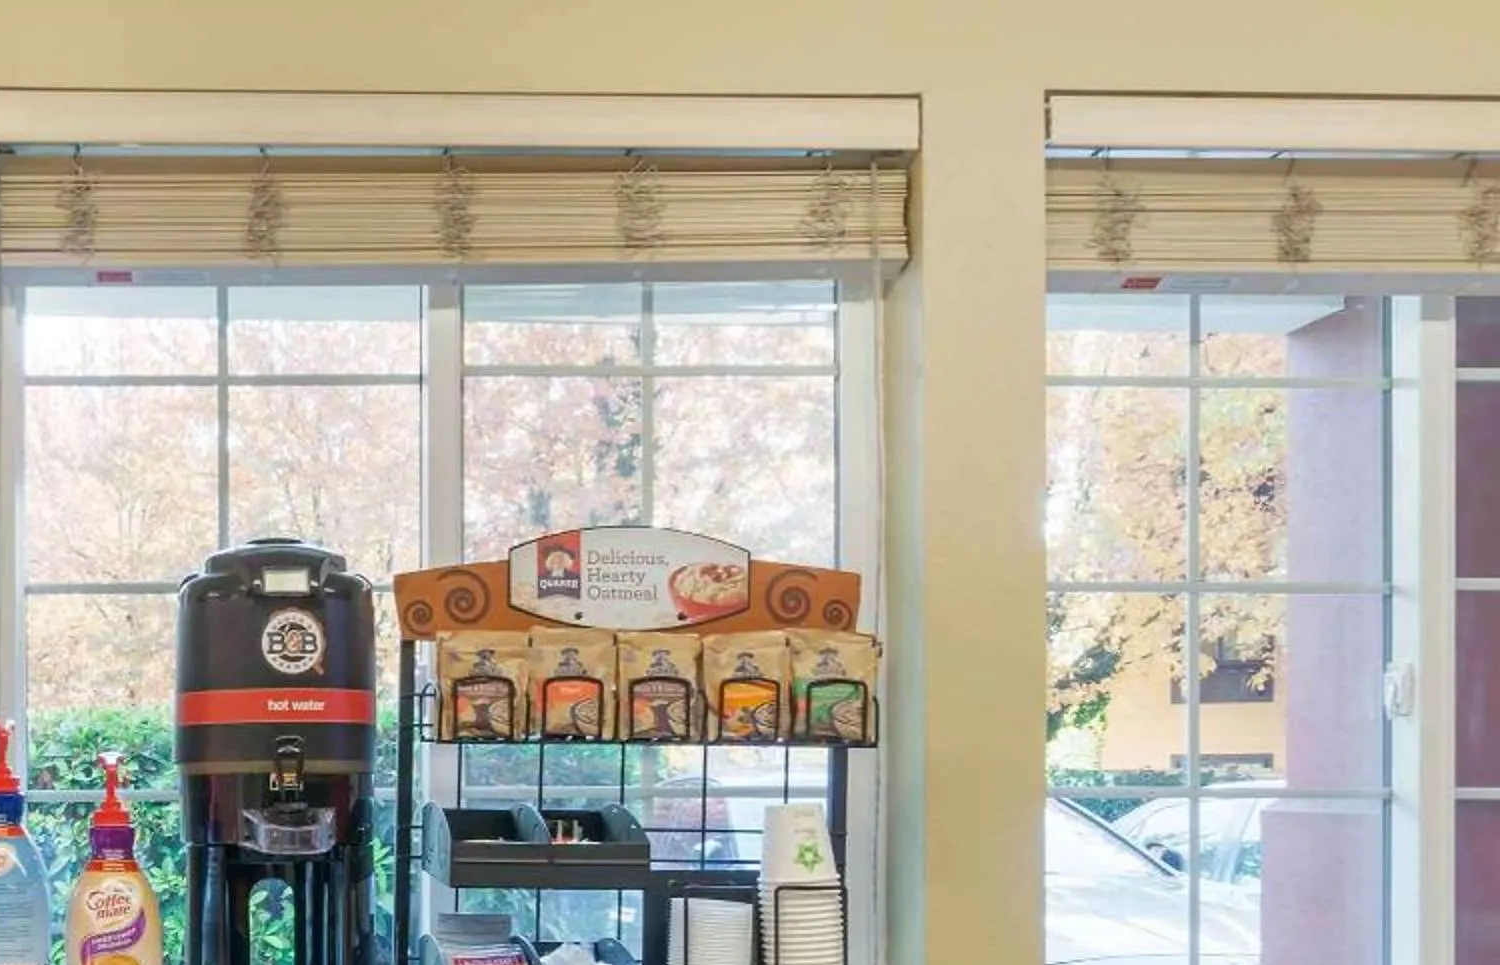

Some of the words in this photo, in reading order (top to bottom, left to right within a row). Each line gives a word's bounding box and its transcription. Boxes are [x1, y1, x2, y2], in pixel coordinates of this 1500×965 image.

[587, 550, 670, 566] Delicious,
[587, 568, 646, 586] Hearty
[587, 585, 658, 601] Oatmeal
[267, 699, 290, 711] hot
[291, 699, 325, 711] water
